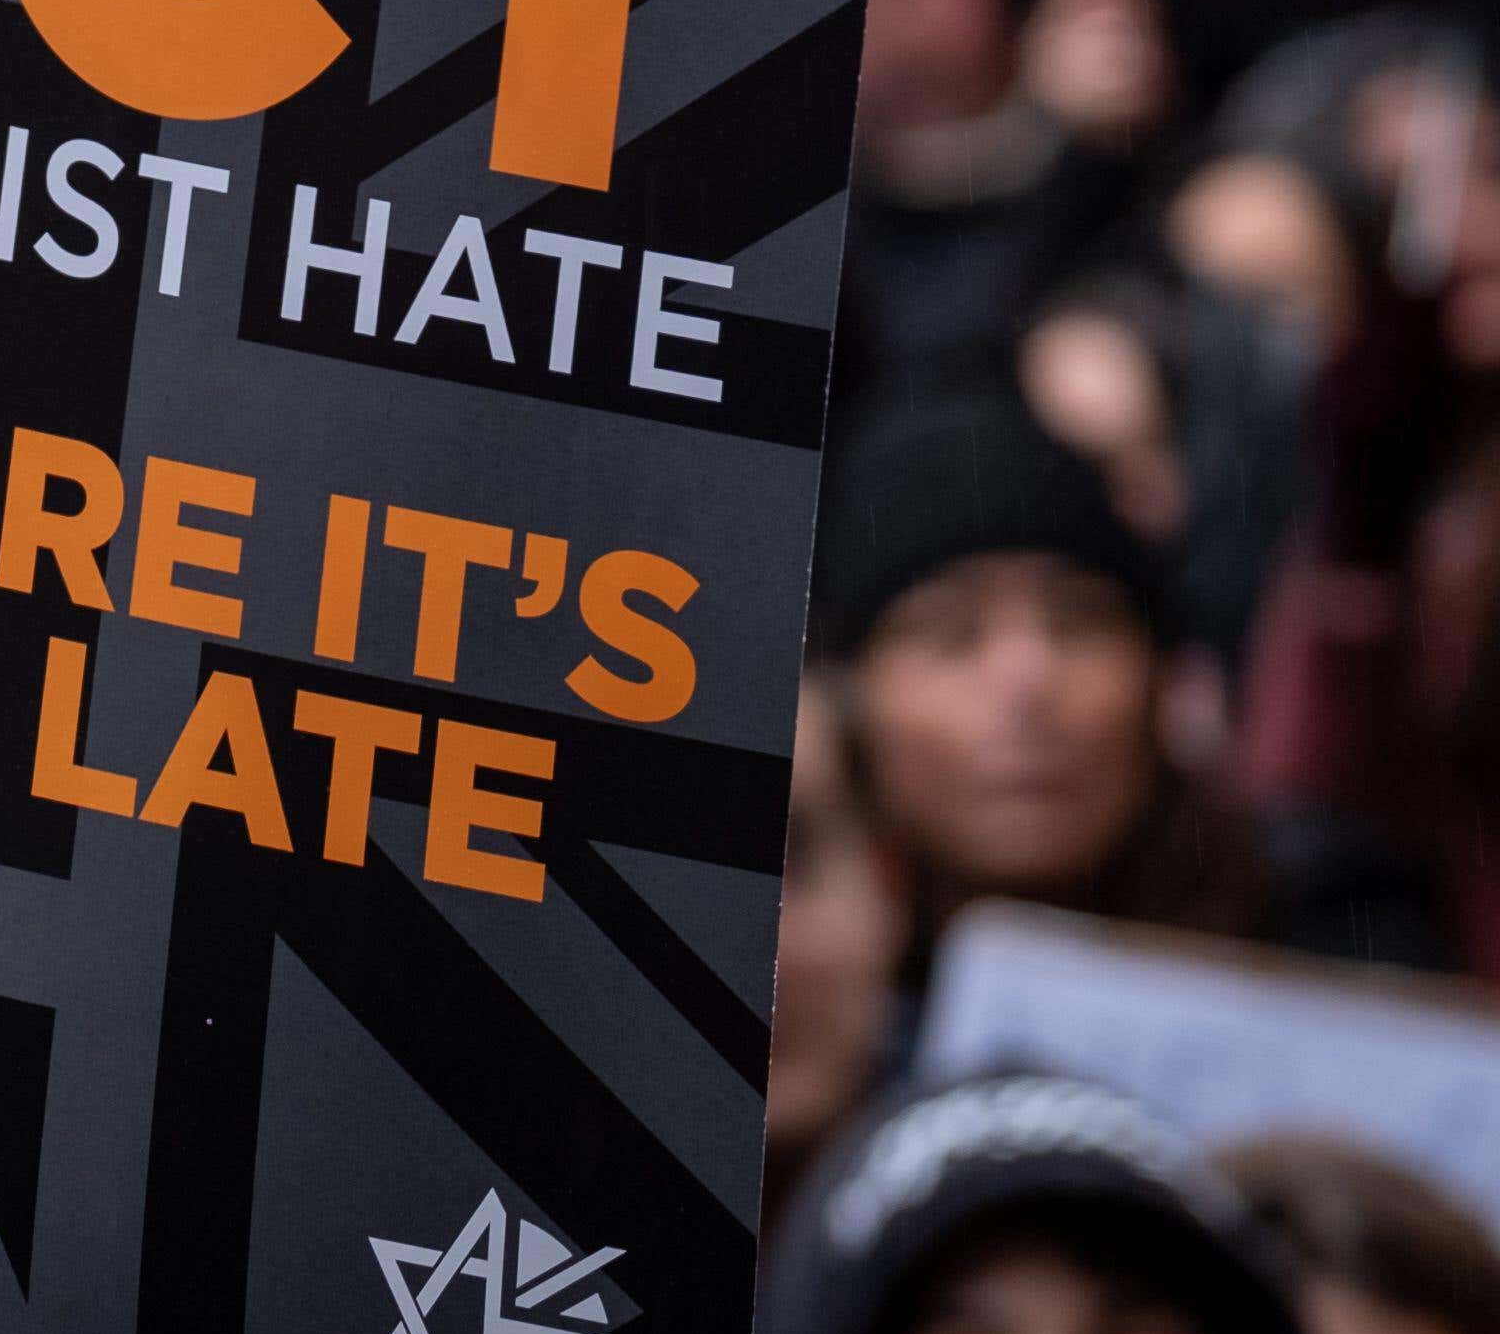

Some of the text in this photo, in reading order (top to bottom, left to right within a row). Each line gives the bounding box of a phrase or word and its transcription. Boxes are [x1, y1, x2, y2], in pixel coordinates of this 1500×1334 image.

[280, 183, 735, 402] HATE
[312, 494, 702, 724] IT'S
[30, 636, 558, 903] LATE
